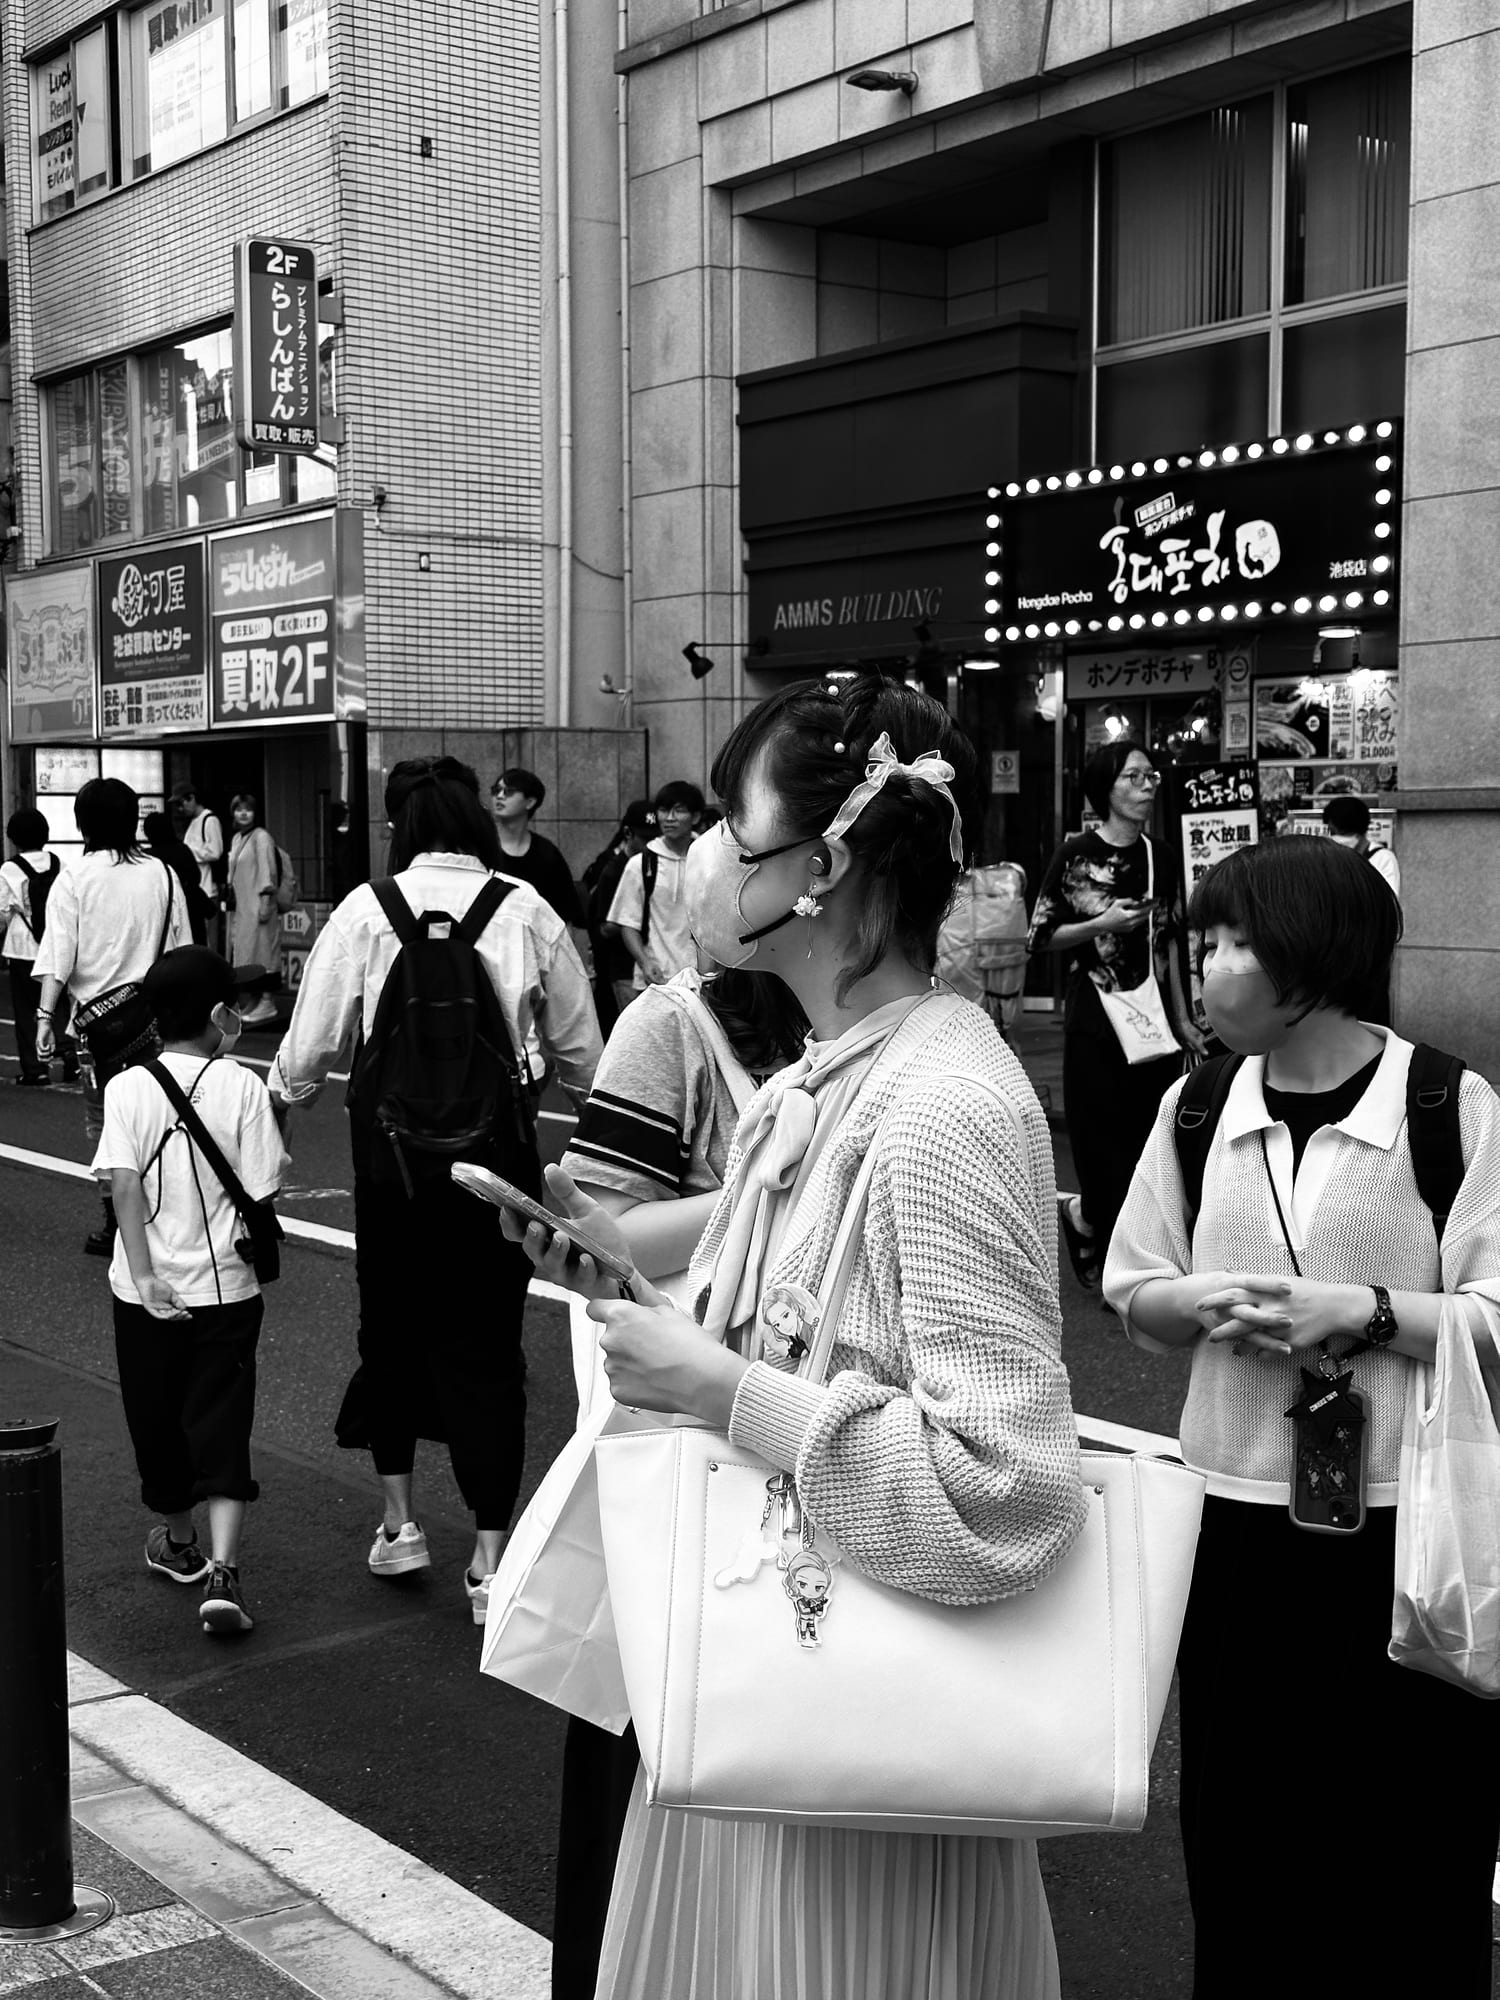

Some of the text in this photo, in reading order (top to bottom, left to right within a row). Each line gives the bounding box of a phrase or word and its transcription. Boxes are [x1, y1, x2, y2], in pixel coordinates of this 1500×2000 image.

[266, 245, 299, 275] 2F
[269, 281, 296, 421] らしんばん
[296, 284, 310, 417] プレミアムアニメショップ
[254, 423, 316, 446] 買取・販売
[1329, 558, 1367, 579] 池袋店
[112, 563, 186, 628] 駿河屋
[773, 586, 943, 631] AMMS BUILDING
[1017, 589, 1093, 611] Hongdae Pocha
[113, 627, 192, 658] 池袋買取センター
[220, 640, 329, 714] 買取2F
[1087, 656, 1195, 689] ホンデポチャ
[1189, 824, 1251, 846] 食べ放題
